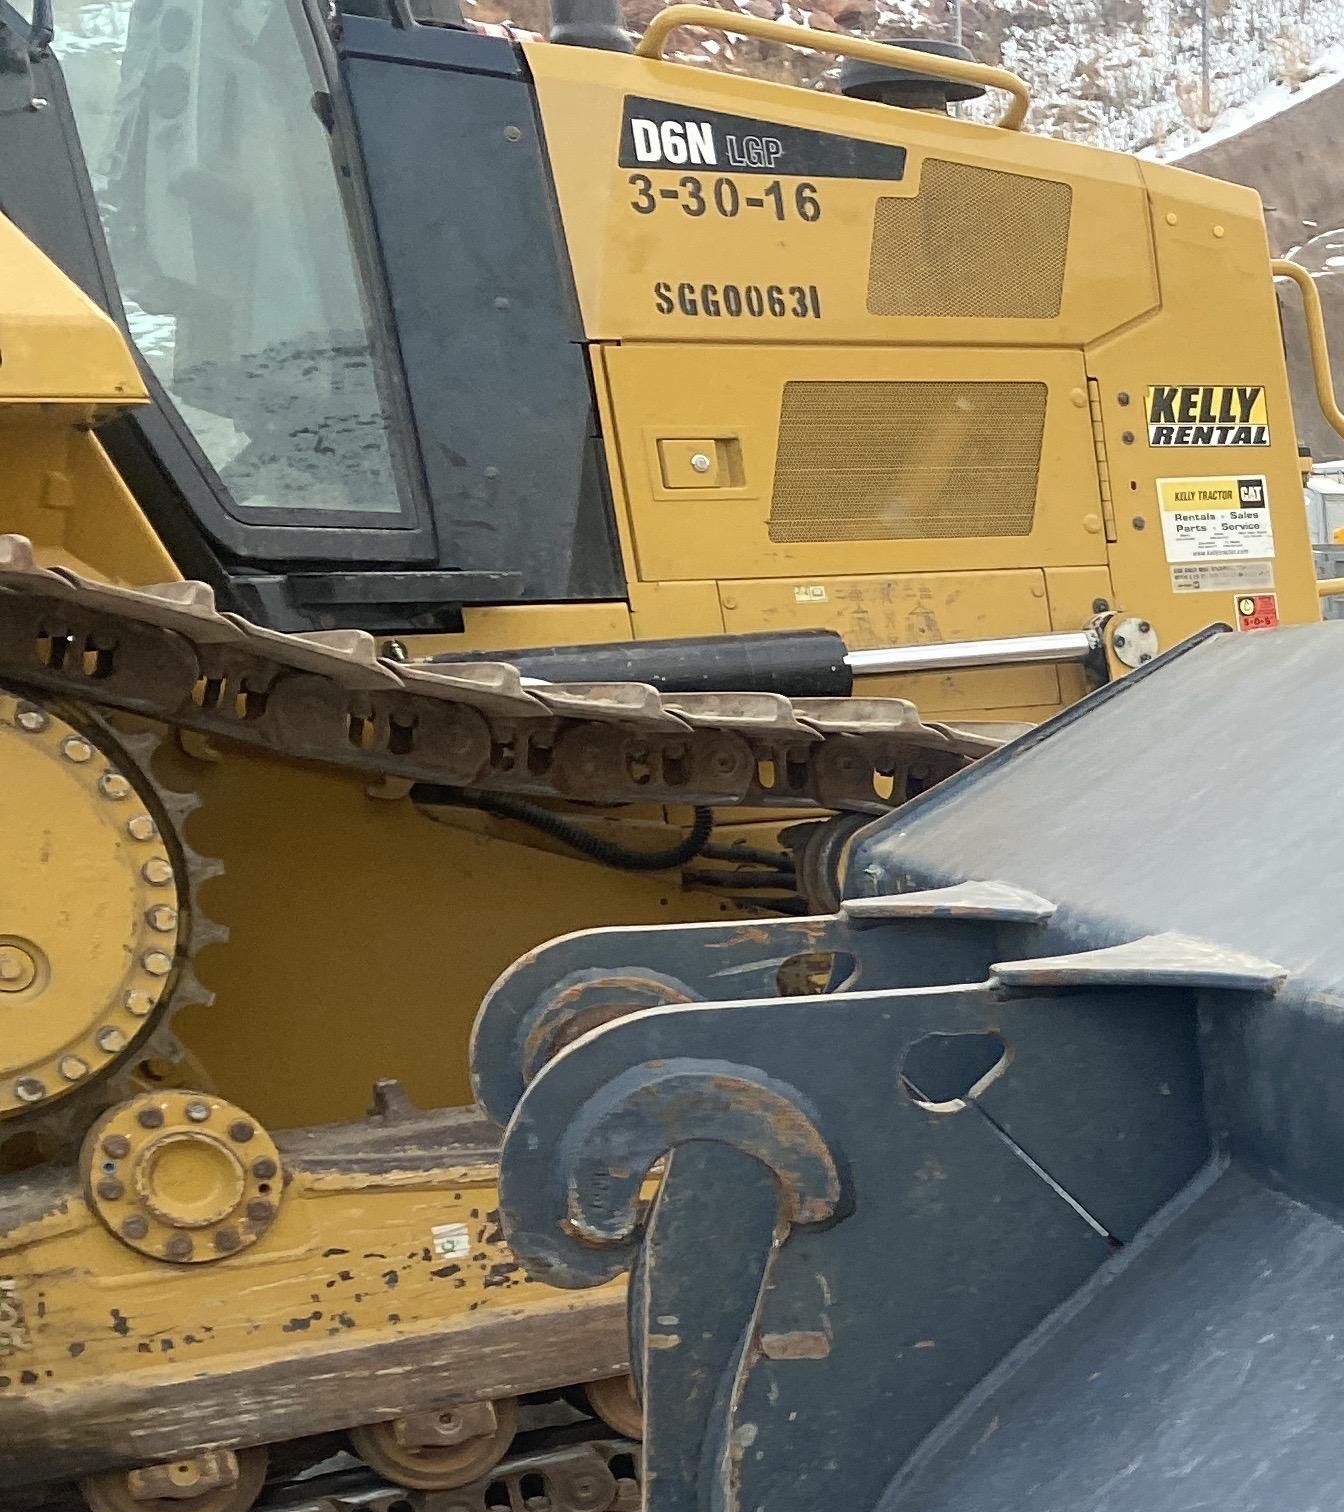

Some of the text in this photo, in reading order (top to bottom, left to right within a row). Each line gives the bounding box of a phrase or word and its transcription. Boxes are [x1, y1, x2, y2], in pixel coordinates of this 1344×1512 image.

[631, 118, 783, 168] D6N LGP
[628, 173, 821, 222] 3-30-16
[1150, 387, 1261, 423] KELLY
[1151, 426, 1267, 445] RENTAL
[1174, 486, 1262, 502] KELLY TRACTOR CAT
[1174, 511, 1259, 522] Rentals Sales
[1176, 522, 1260, 532] Parts Service
